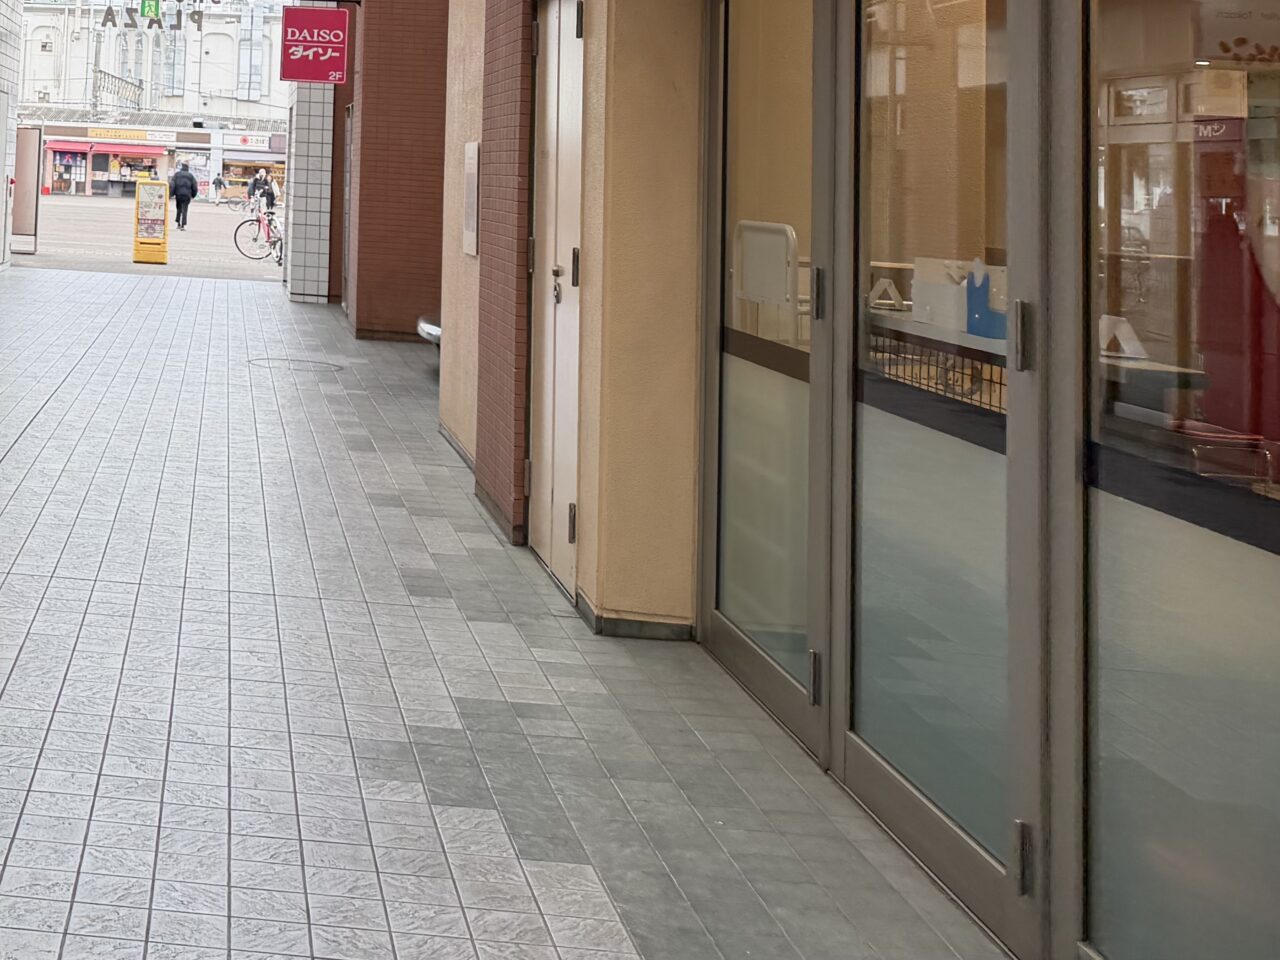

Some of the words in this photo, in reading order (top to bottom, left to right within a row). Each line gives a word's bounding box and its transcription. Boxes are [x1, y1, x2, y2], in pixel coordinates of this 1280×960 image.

[286, 28, 344, 42] DAISO
[289, 45, 340, 60] ダイソー
[328, 71, 343, 80] 2F
